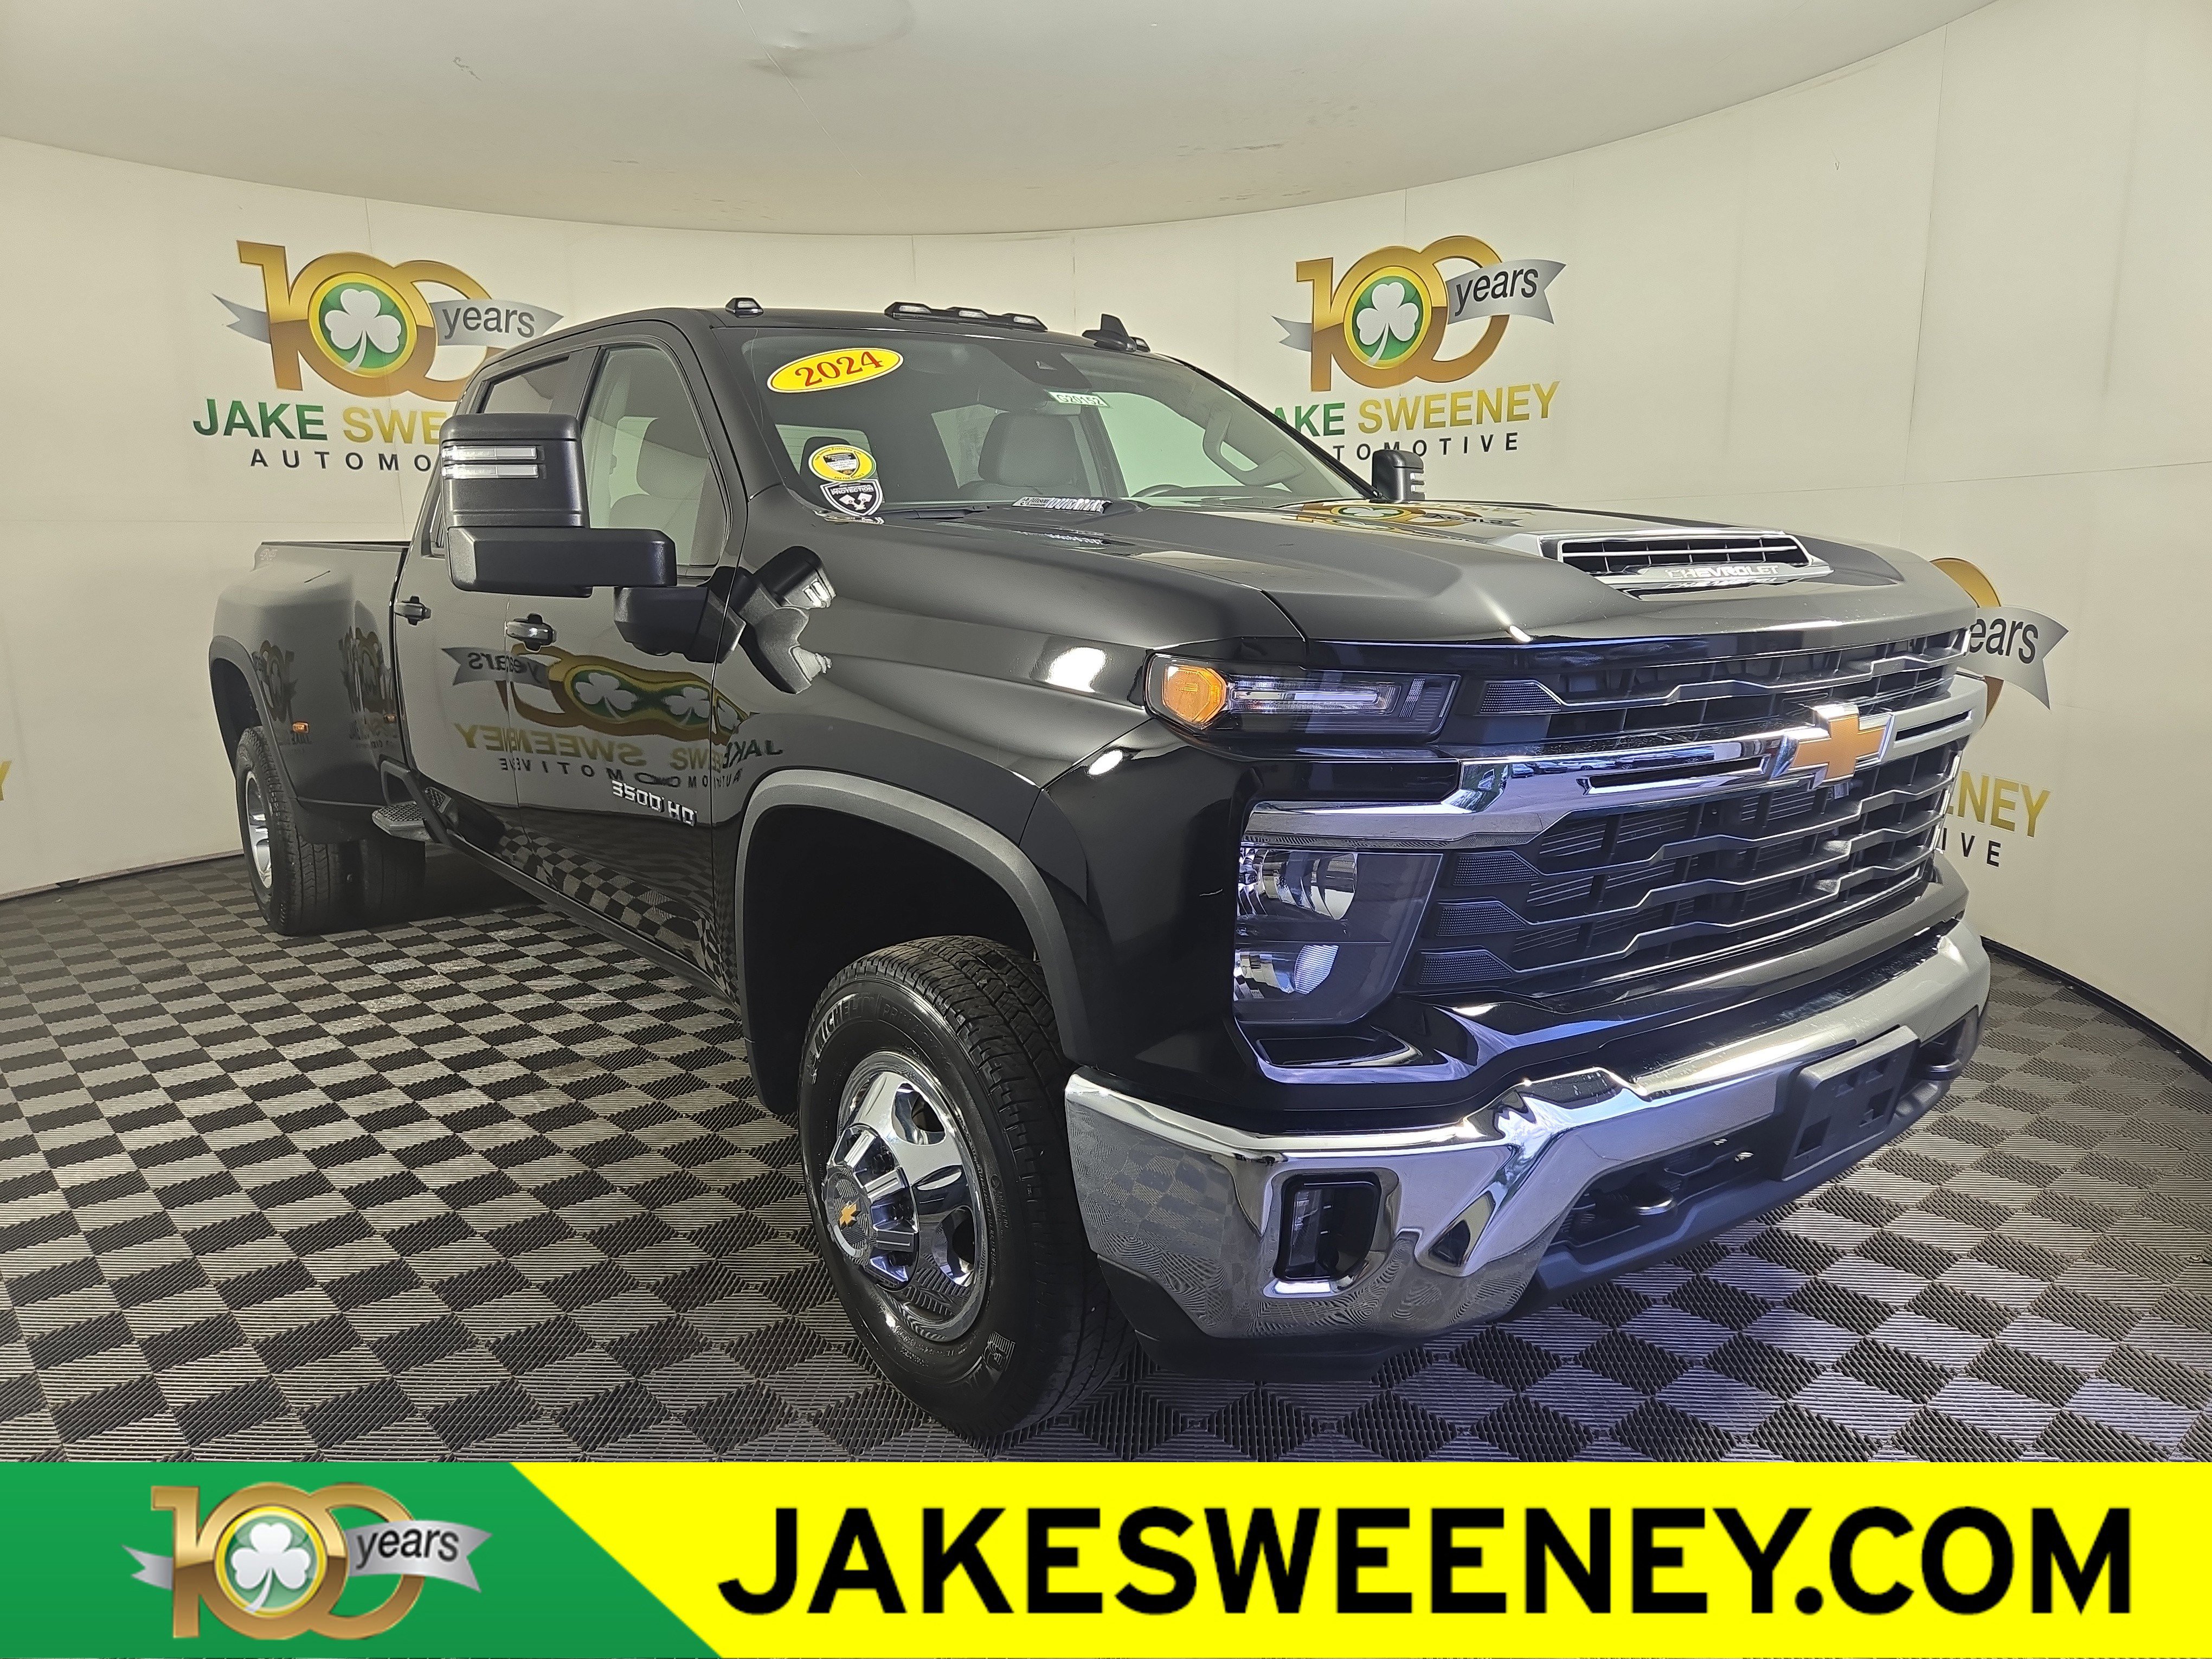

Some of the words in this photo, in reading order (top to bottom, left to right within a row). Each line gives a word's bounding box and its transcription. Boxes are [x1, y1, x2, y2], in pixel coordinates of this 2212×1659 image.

[236, 239, 494, 402] 100
[442, 306, 536, 338] years
[1296, 235, 1509, 392] 100
[1455, 268, 1539, 317] years
[795, 351, 884, 387] 2024
[193, 398, 328, 441] JAKE
[1057, 394, 1104, 406] G20152
[1358, 381, 1560, 434] SWEENEY
[250, 449, 432, 472] AUTOMO
[831, 486, 874, 496] PROTECTION
[1665, 565, 1779, 579] CHEVROLET
[612, 780, 665, 813] 3500
[667, 800, 699, 827] HD
